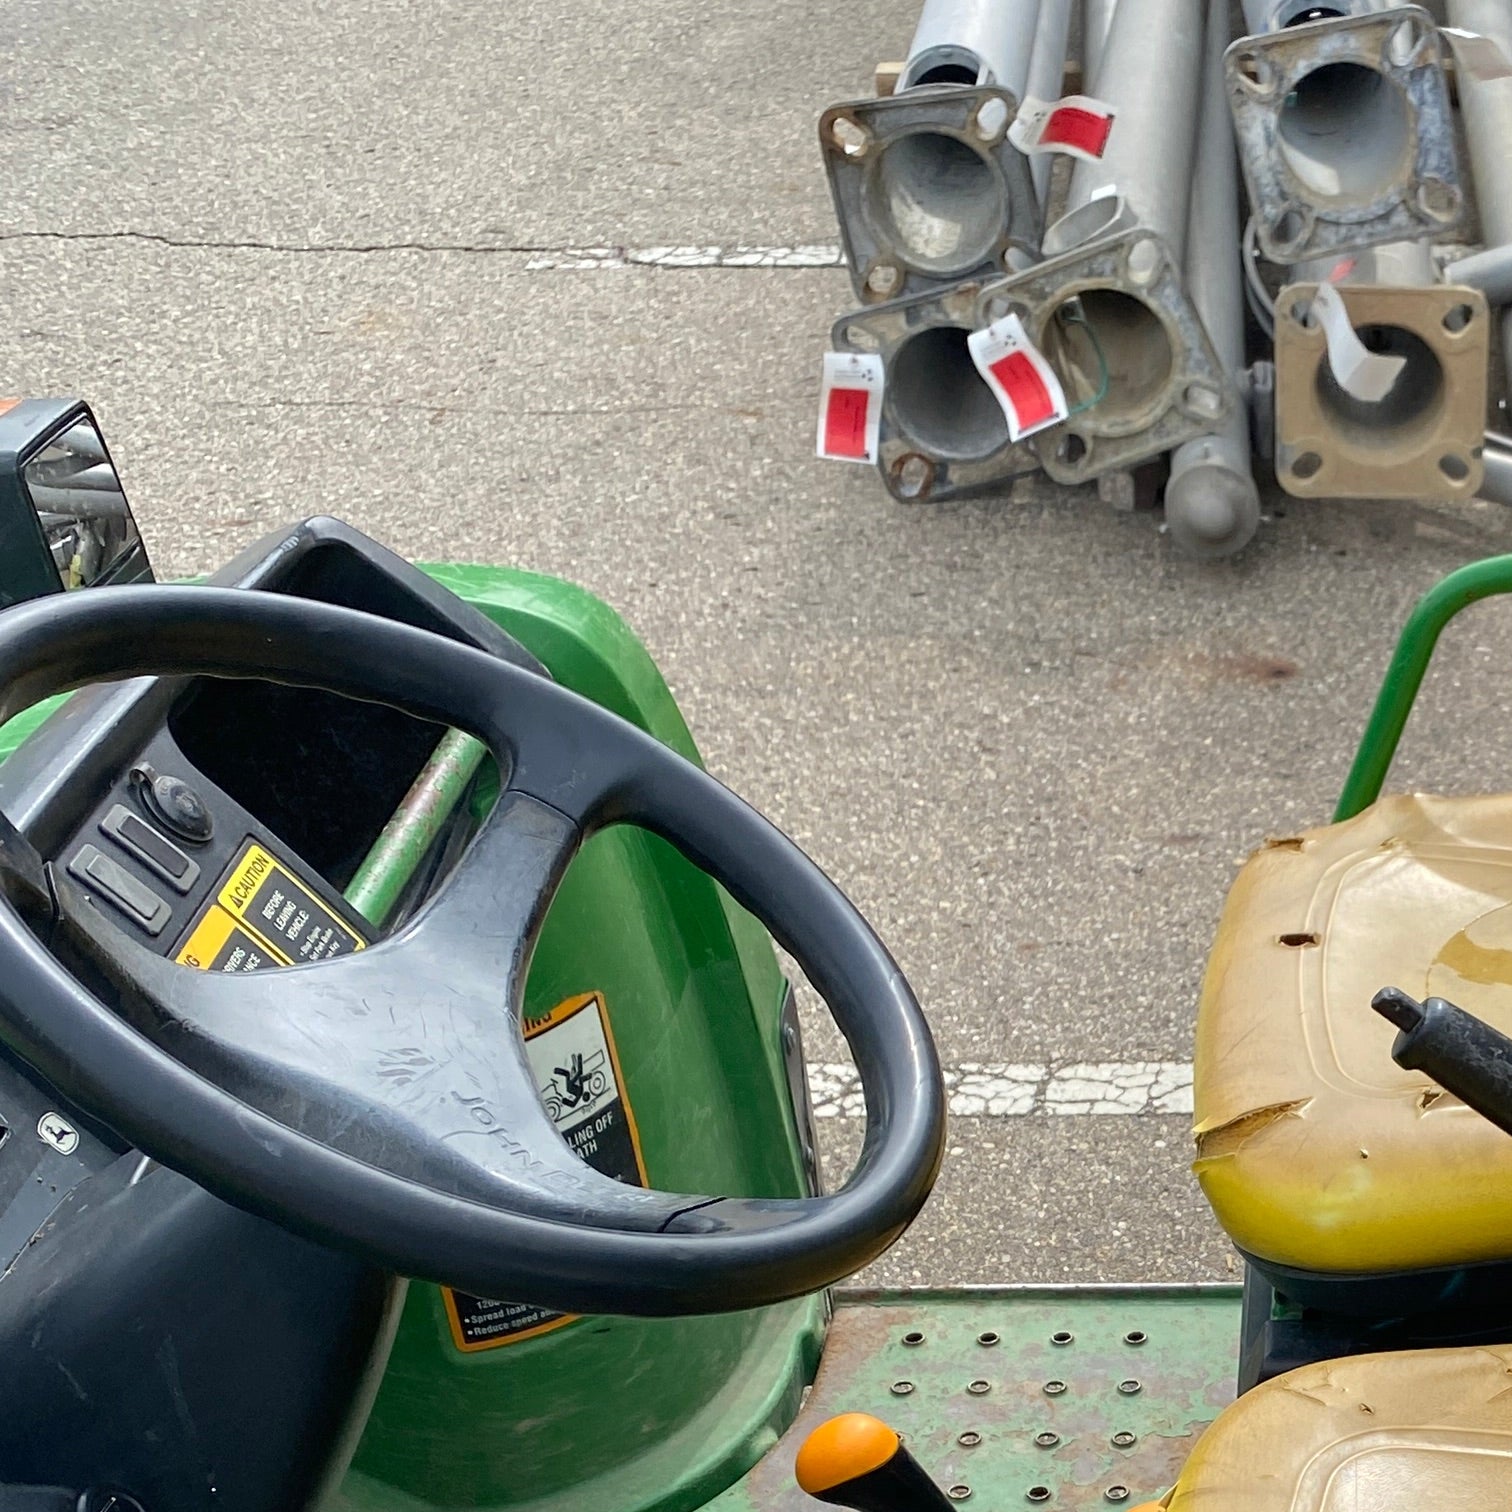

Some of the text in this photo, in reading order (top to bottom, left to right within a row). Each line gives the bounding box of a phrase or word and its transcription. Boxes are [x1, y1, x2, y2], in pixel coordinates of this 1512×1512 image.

[235, 854, 269, 899] CAUTION
[262, 890, 284, 920] BEFORE
[274, 900, 296, 931] LEAVING
[450, 1090, 544, 1168] JOHN
[568, 1111, 614, 1148] LING OFF
[576, 1140, 598, 1160] ATH
[470, 1304, 526, 1324] Spread load
[474, 1322, 510, 1336] Reduce
[511, 1312, 538, 1327] speed
